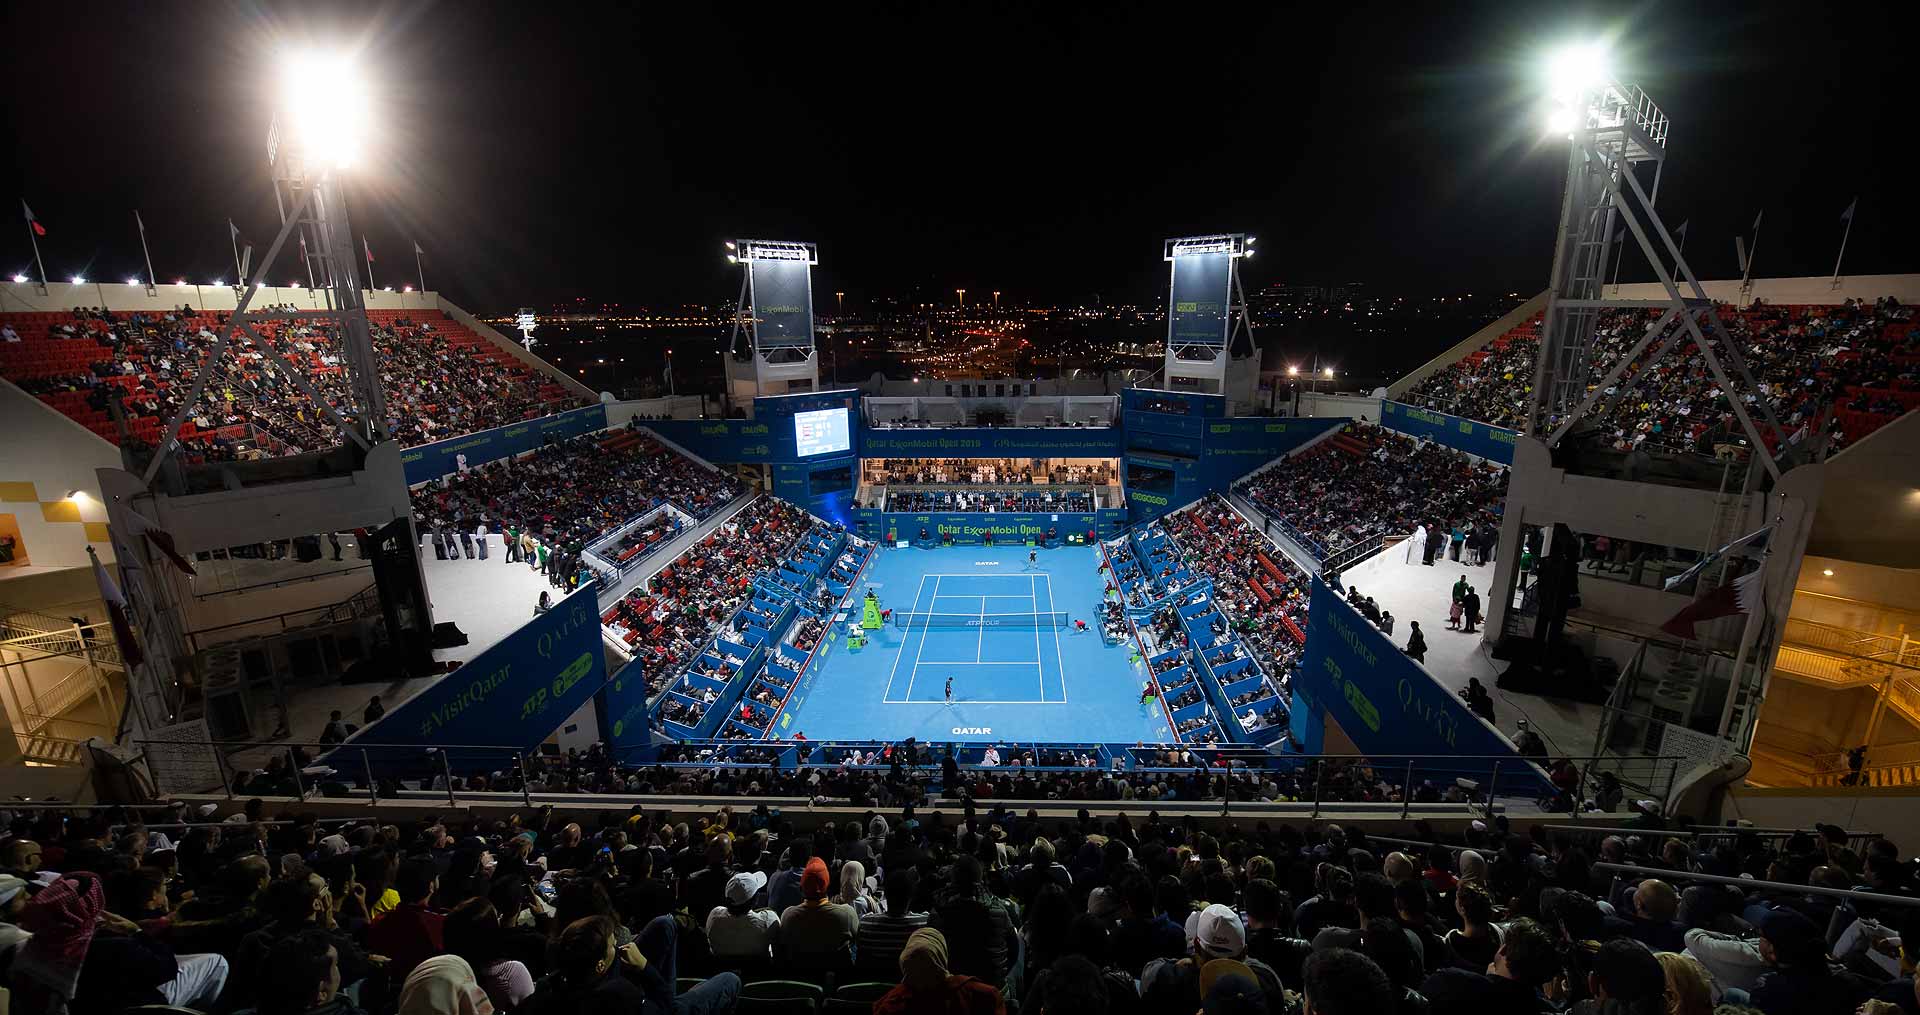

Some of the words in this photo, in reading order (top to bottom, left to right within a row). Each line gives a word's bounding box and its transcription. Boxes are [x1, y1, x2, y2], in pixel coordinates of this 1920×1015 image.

[761, 305, 804, 313] ExxonMobil
[938, 523, 961, 535] Qatar
[963, 525, 1018, 537] ExxonMobil
[1020, 524, 1041, 536] Open
[1327, 610, 1377, 667] #VisitQatar
[421, 663, 511, 736] #VisitQatar
[521, 687, 547, 720] ATP
[951, 727, 992, 735] QATAR
